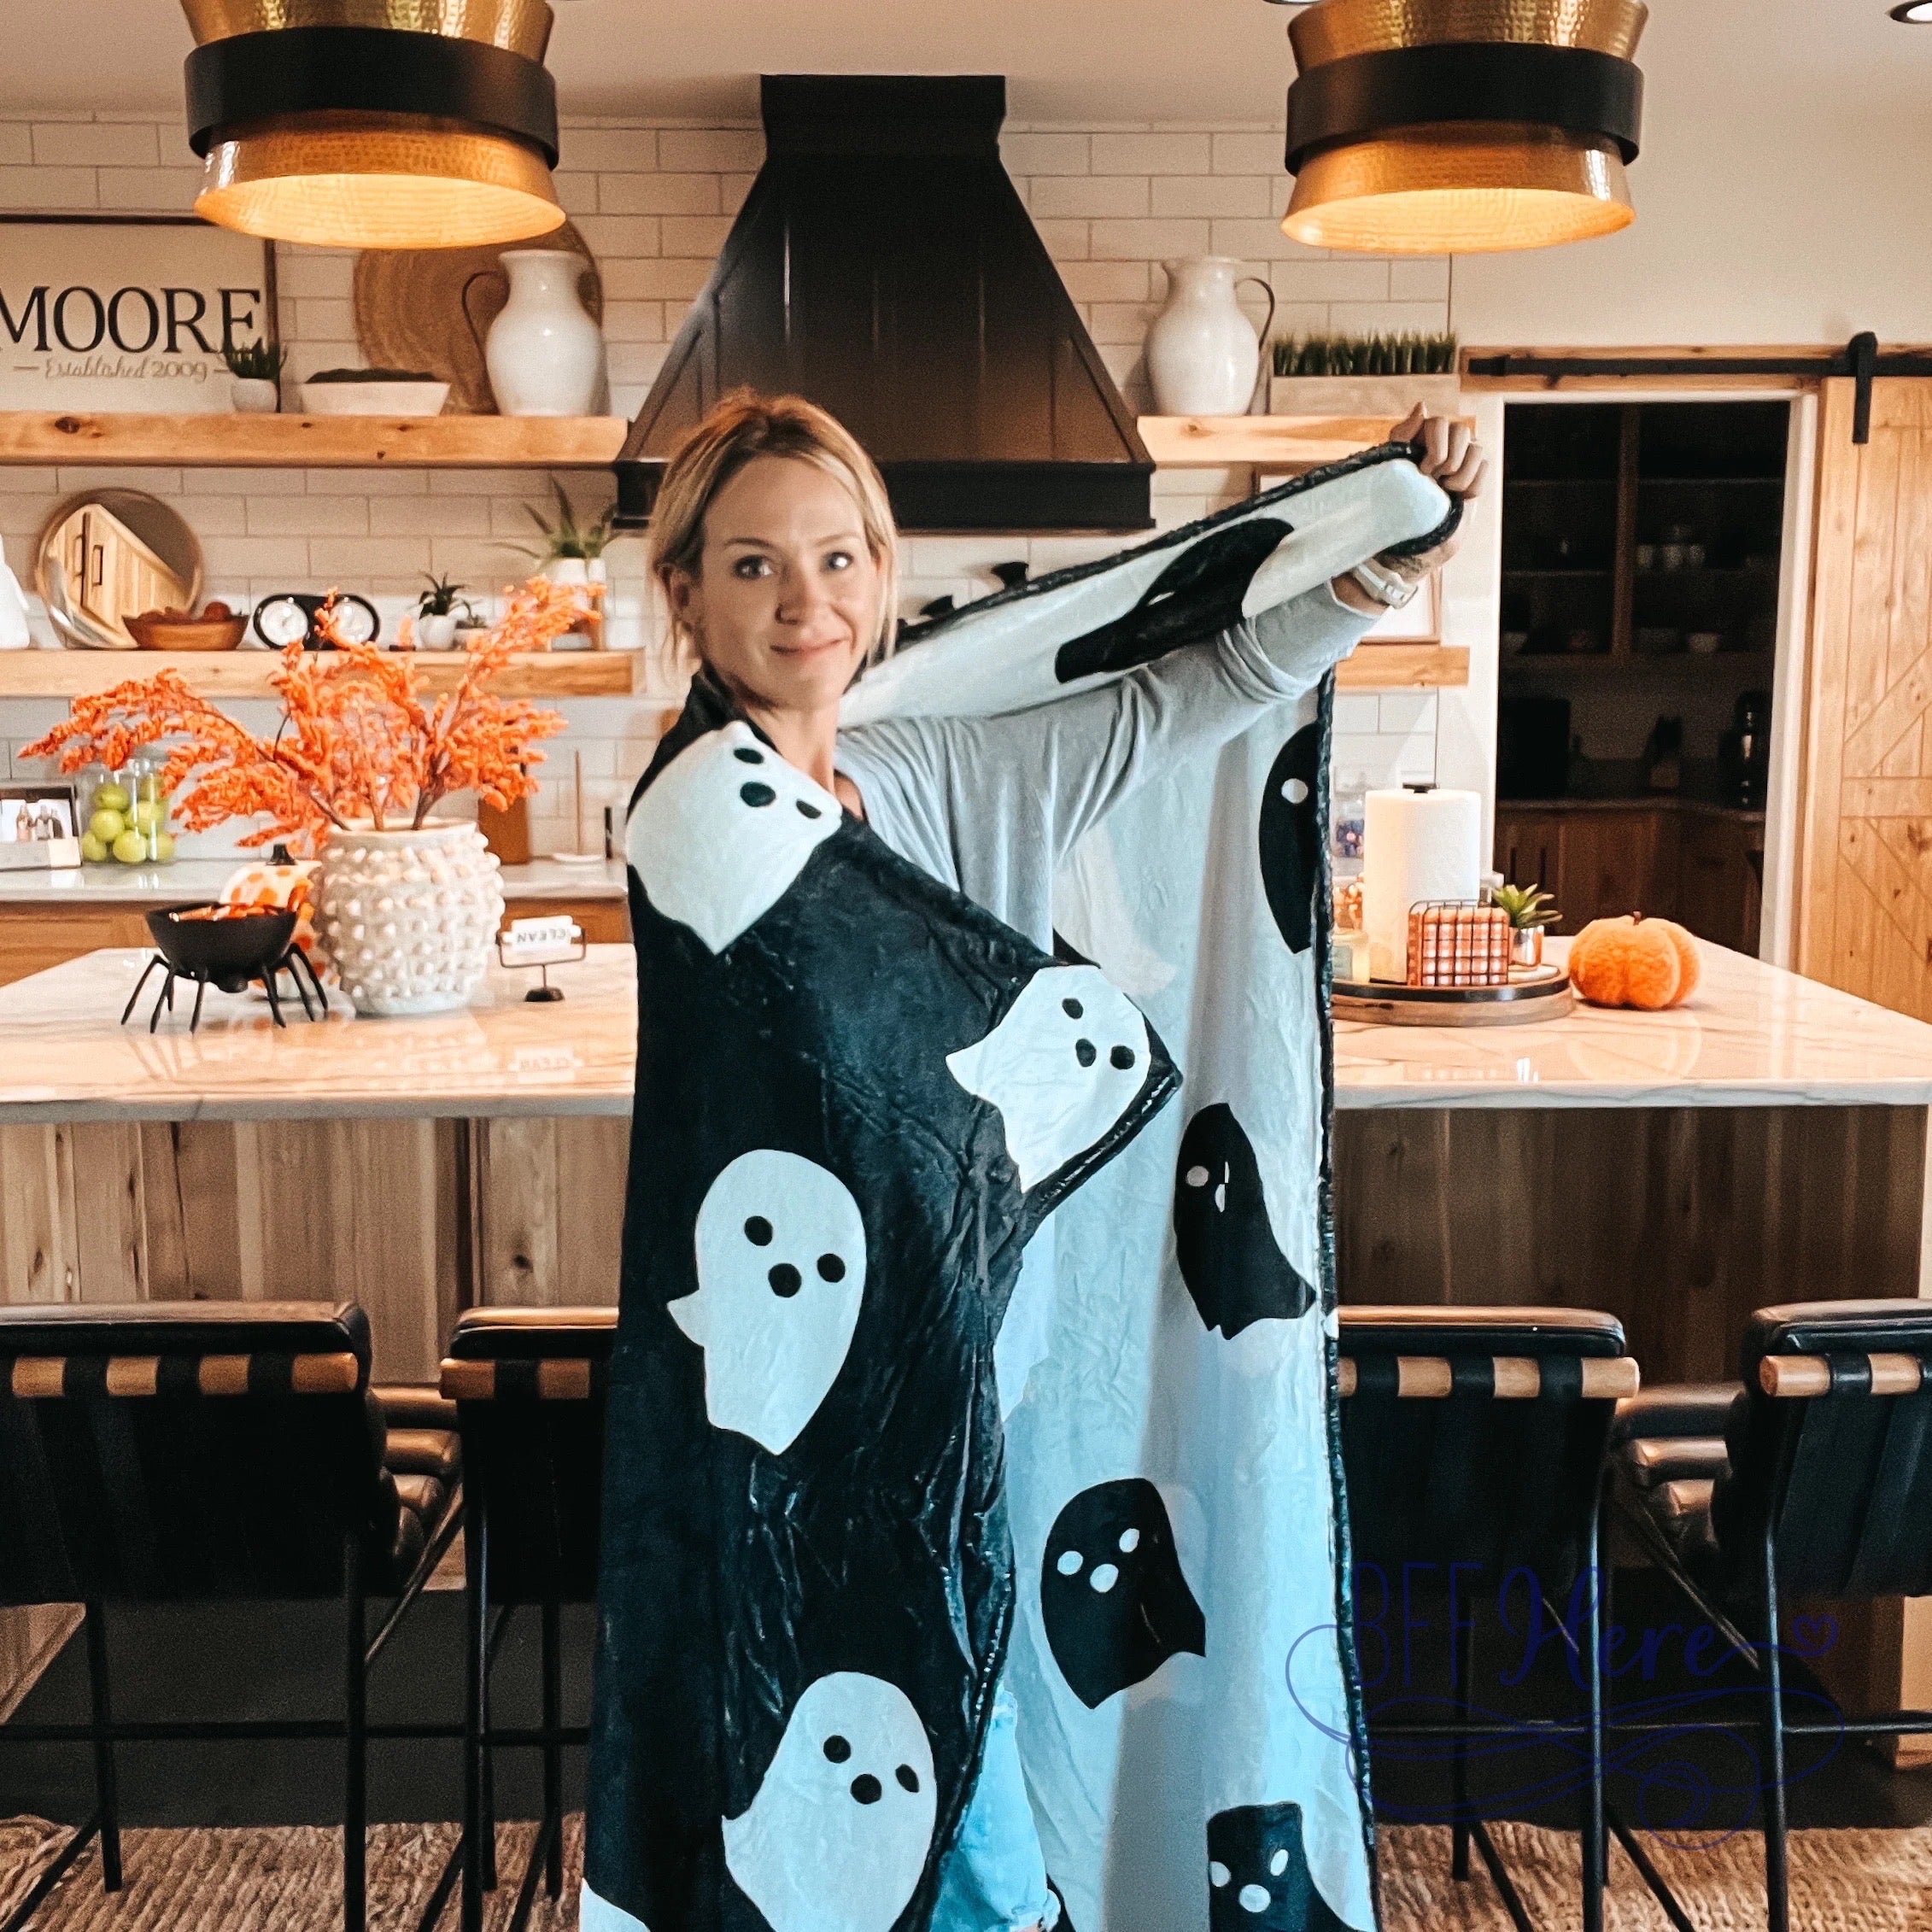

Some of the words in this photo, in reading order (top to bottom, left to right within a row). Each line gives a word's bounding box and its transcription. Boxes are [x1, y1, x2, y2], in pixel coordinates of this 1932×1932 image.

[0, 285, 261, 353] MOORE
[45, 355, 148, 378] Established
[151, 360, 208, 383] 2009
[517, 928, 566, 943] CLEAN
